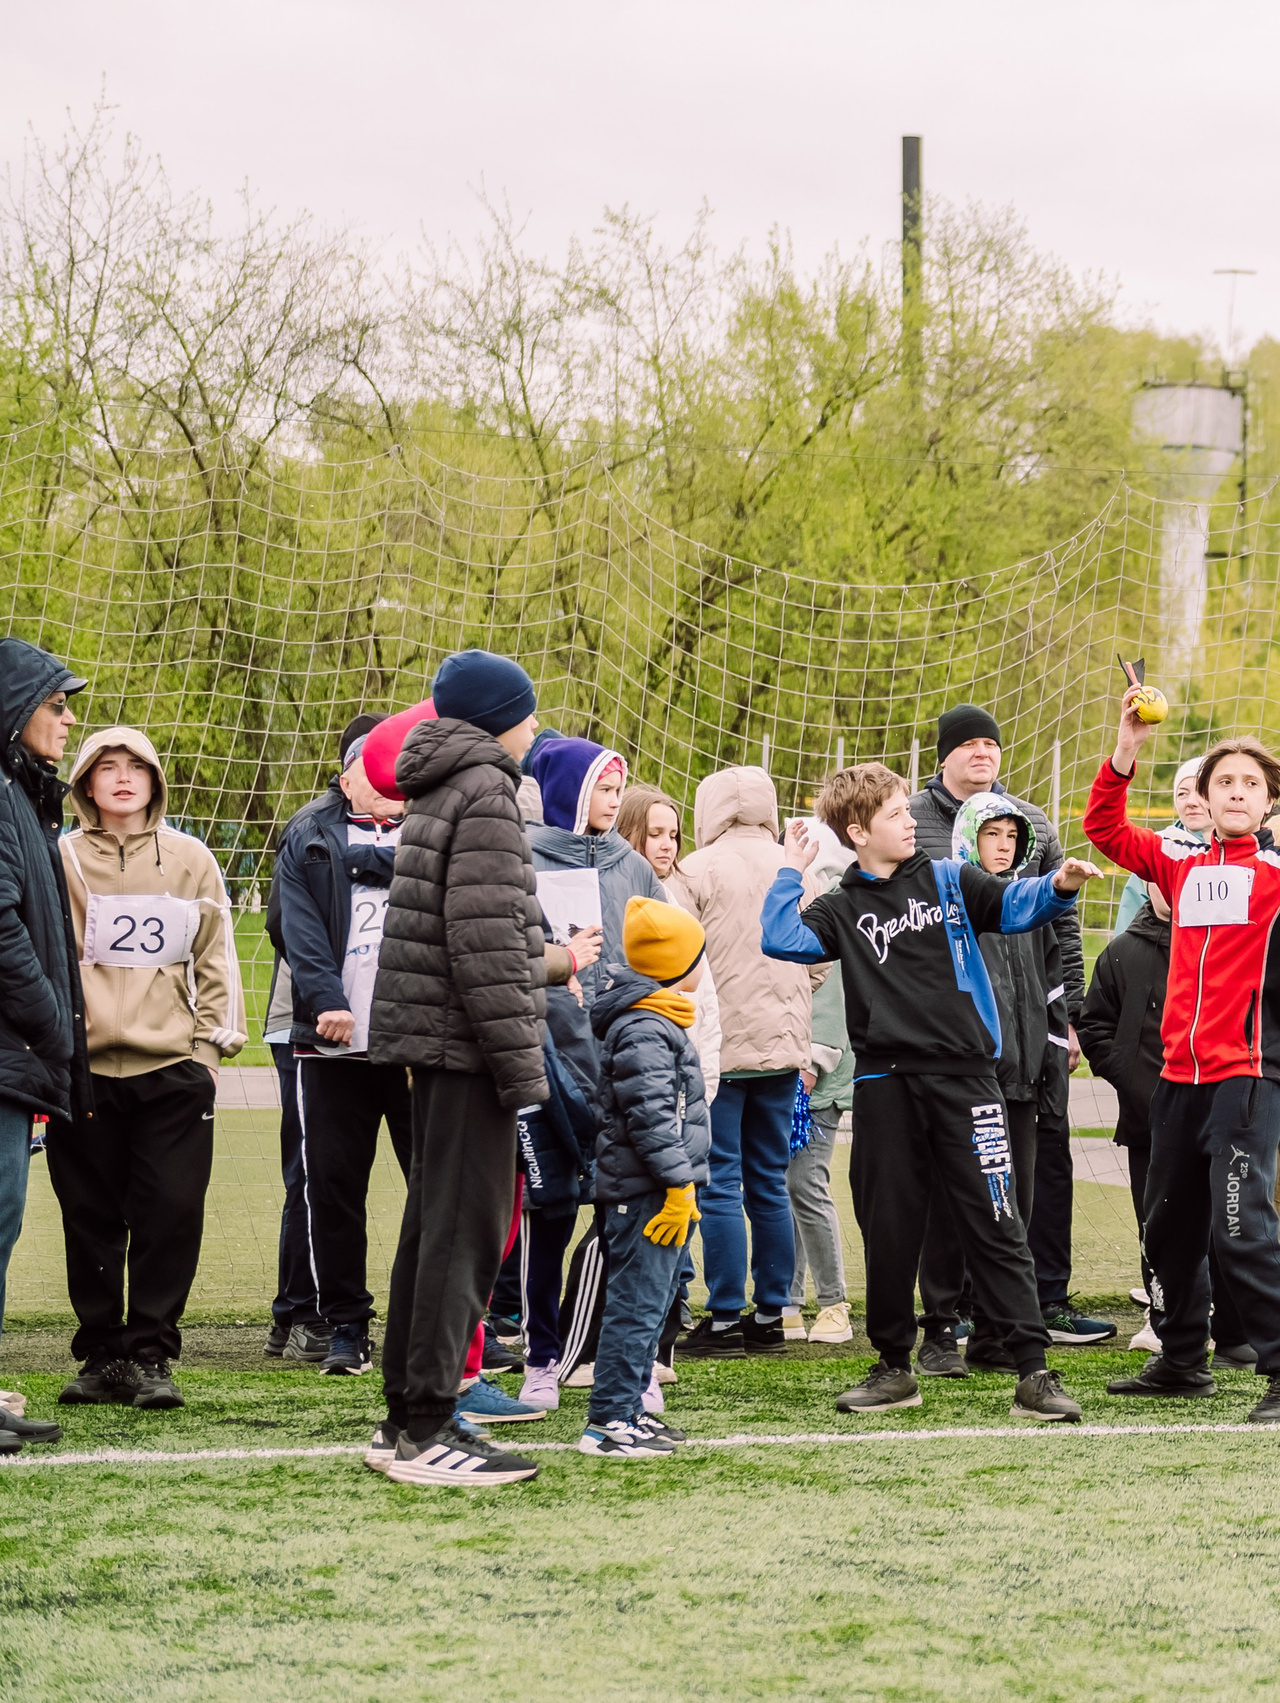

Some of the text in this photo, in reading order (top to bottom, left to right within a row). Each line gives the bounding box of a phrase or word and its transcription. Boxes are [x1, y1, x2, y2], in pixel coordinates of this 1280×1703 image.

[1197, 880, 1229, 902] 110
[109, 914, 165, 954] 23
[355, 899, 390, 934] 2
[1226, 1172, 1241, 1237] JORDAN
